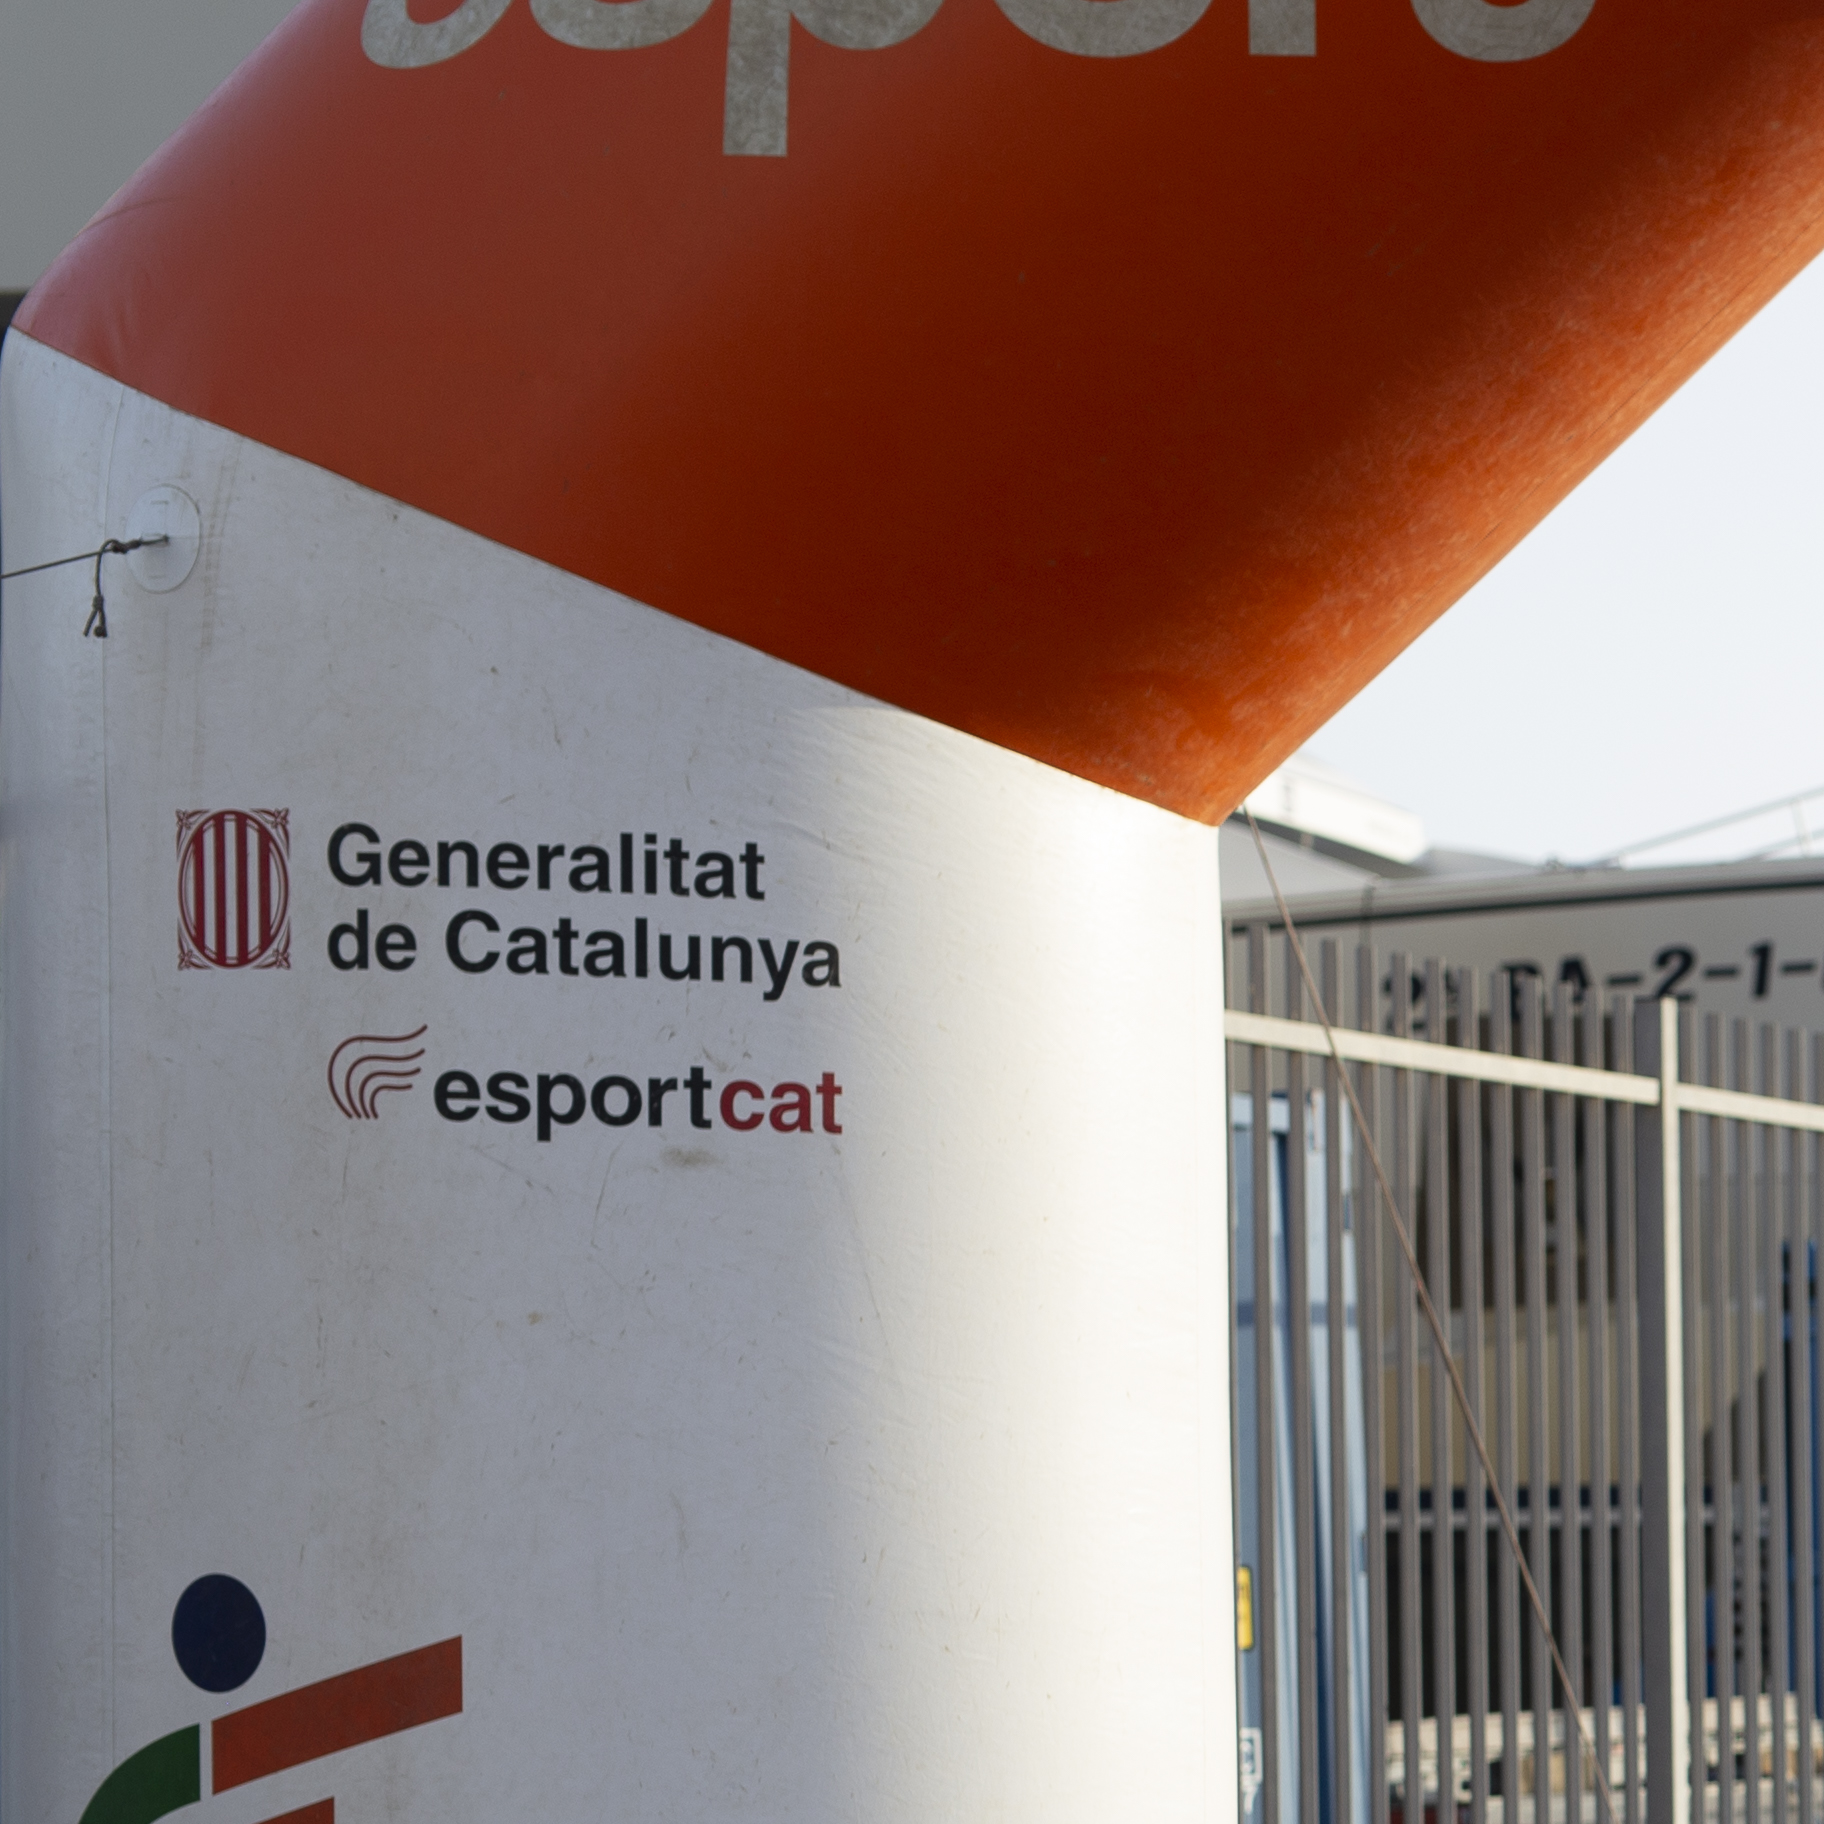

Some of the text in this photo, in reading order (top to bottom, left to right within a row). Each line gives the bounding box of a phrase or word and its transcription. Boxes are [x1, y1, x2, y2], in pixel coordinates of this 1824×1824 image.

[326, 822, 766, 901] Generalitat
[326, 908, 843, 1001] de Catalunya
[433, 1065, 844, 1143] esportcat
